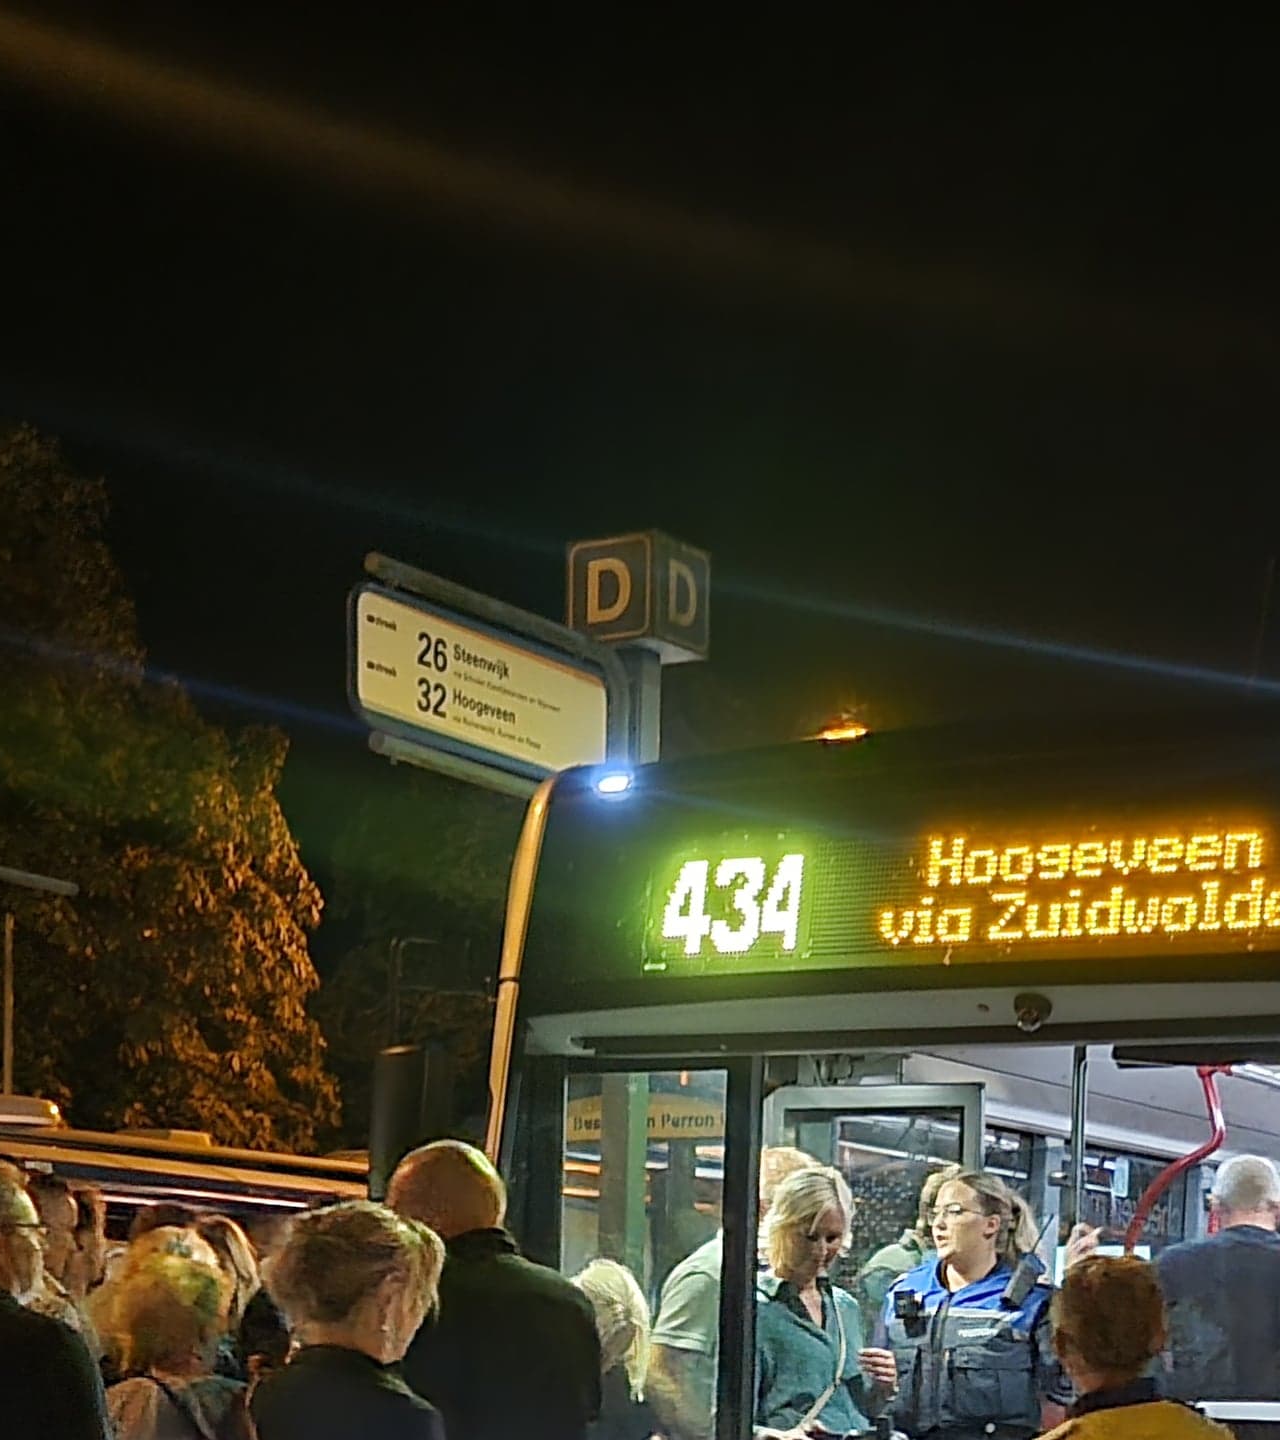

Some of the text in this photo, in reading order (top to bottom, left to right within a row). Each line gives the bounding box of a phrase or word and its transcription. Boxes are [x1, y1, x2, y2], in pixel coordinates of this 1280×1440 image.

[587, 558, 631, 624] D
[668, 559, 697, 627] D
[417, 632, 510, 680] 26 Steenwijk
[417, 677, 447, 718] 32
[453, 688, 516, 725] Hoogeveen
[926, 832, 1263, 887] Hoogeveen
[662, 853, 806, 957] 434
[878, 896, 972, 945] via
[662, 1113, 715, 1129] Perron
